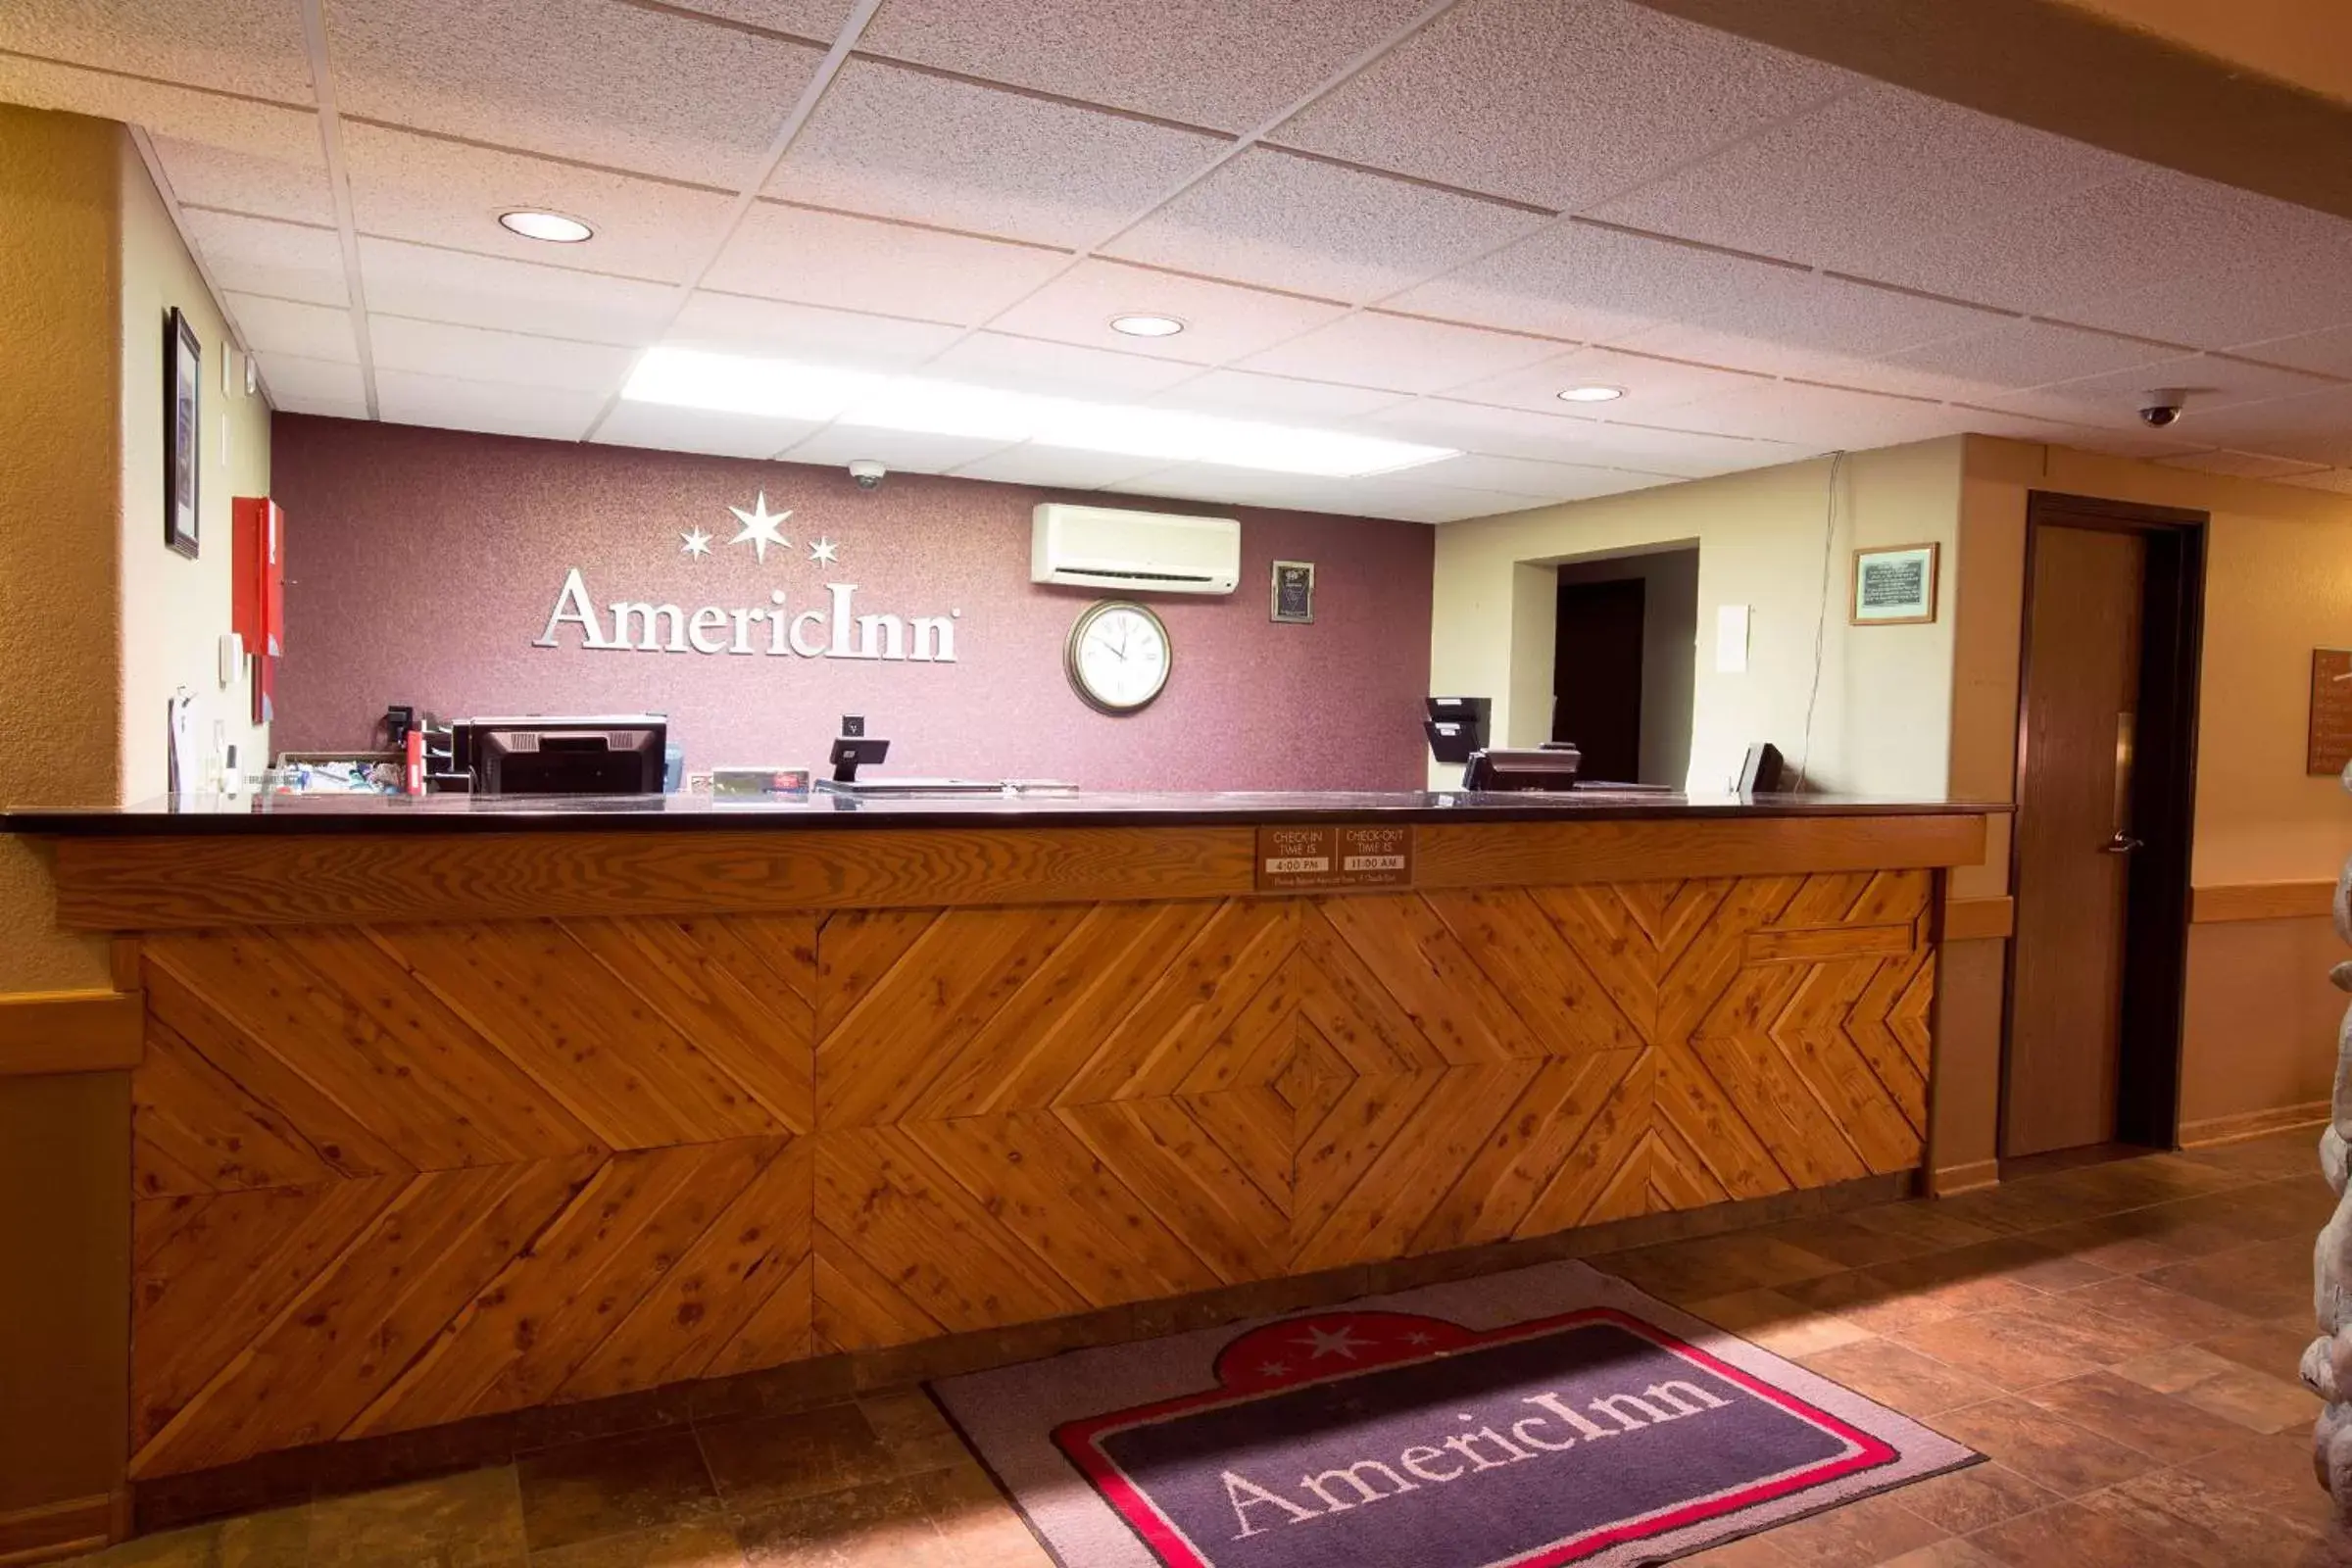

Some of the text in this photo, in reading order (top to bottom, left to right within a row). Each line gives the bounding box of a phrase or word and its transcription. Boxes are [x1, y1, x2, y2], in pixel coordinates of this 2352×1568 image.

[532, 567, 957, 662] AmericInn
[1307, 844, 1317, 854] IS
[1276, 858, 1318, 870] 4:00 PM
[1381, 858, 1396, 867] AM
[1220, 1377, 1735, 1542] AmericInn
